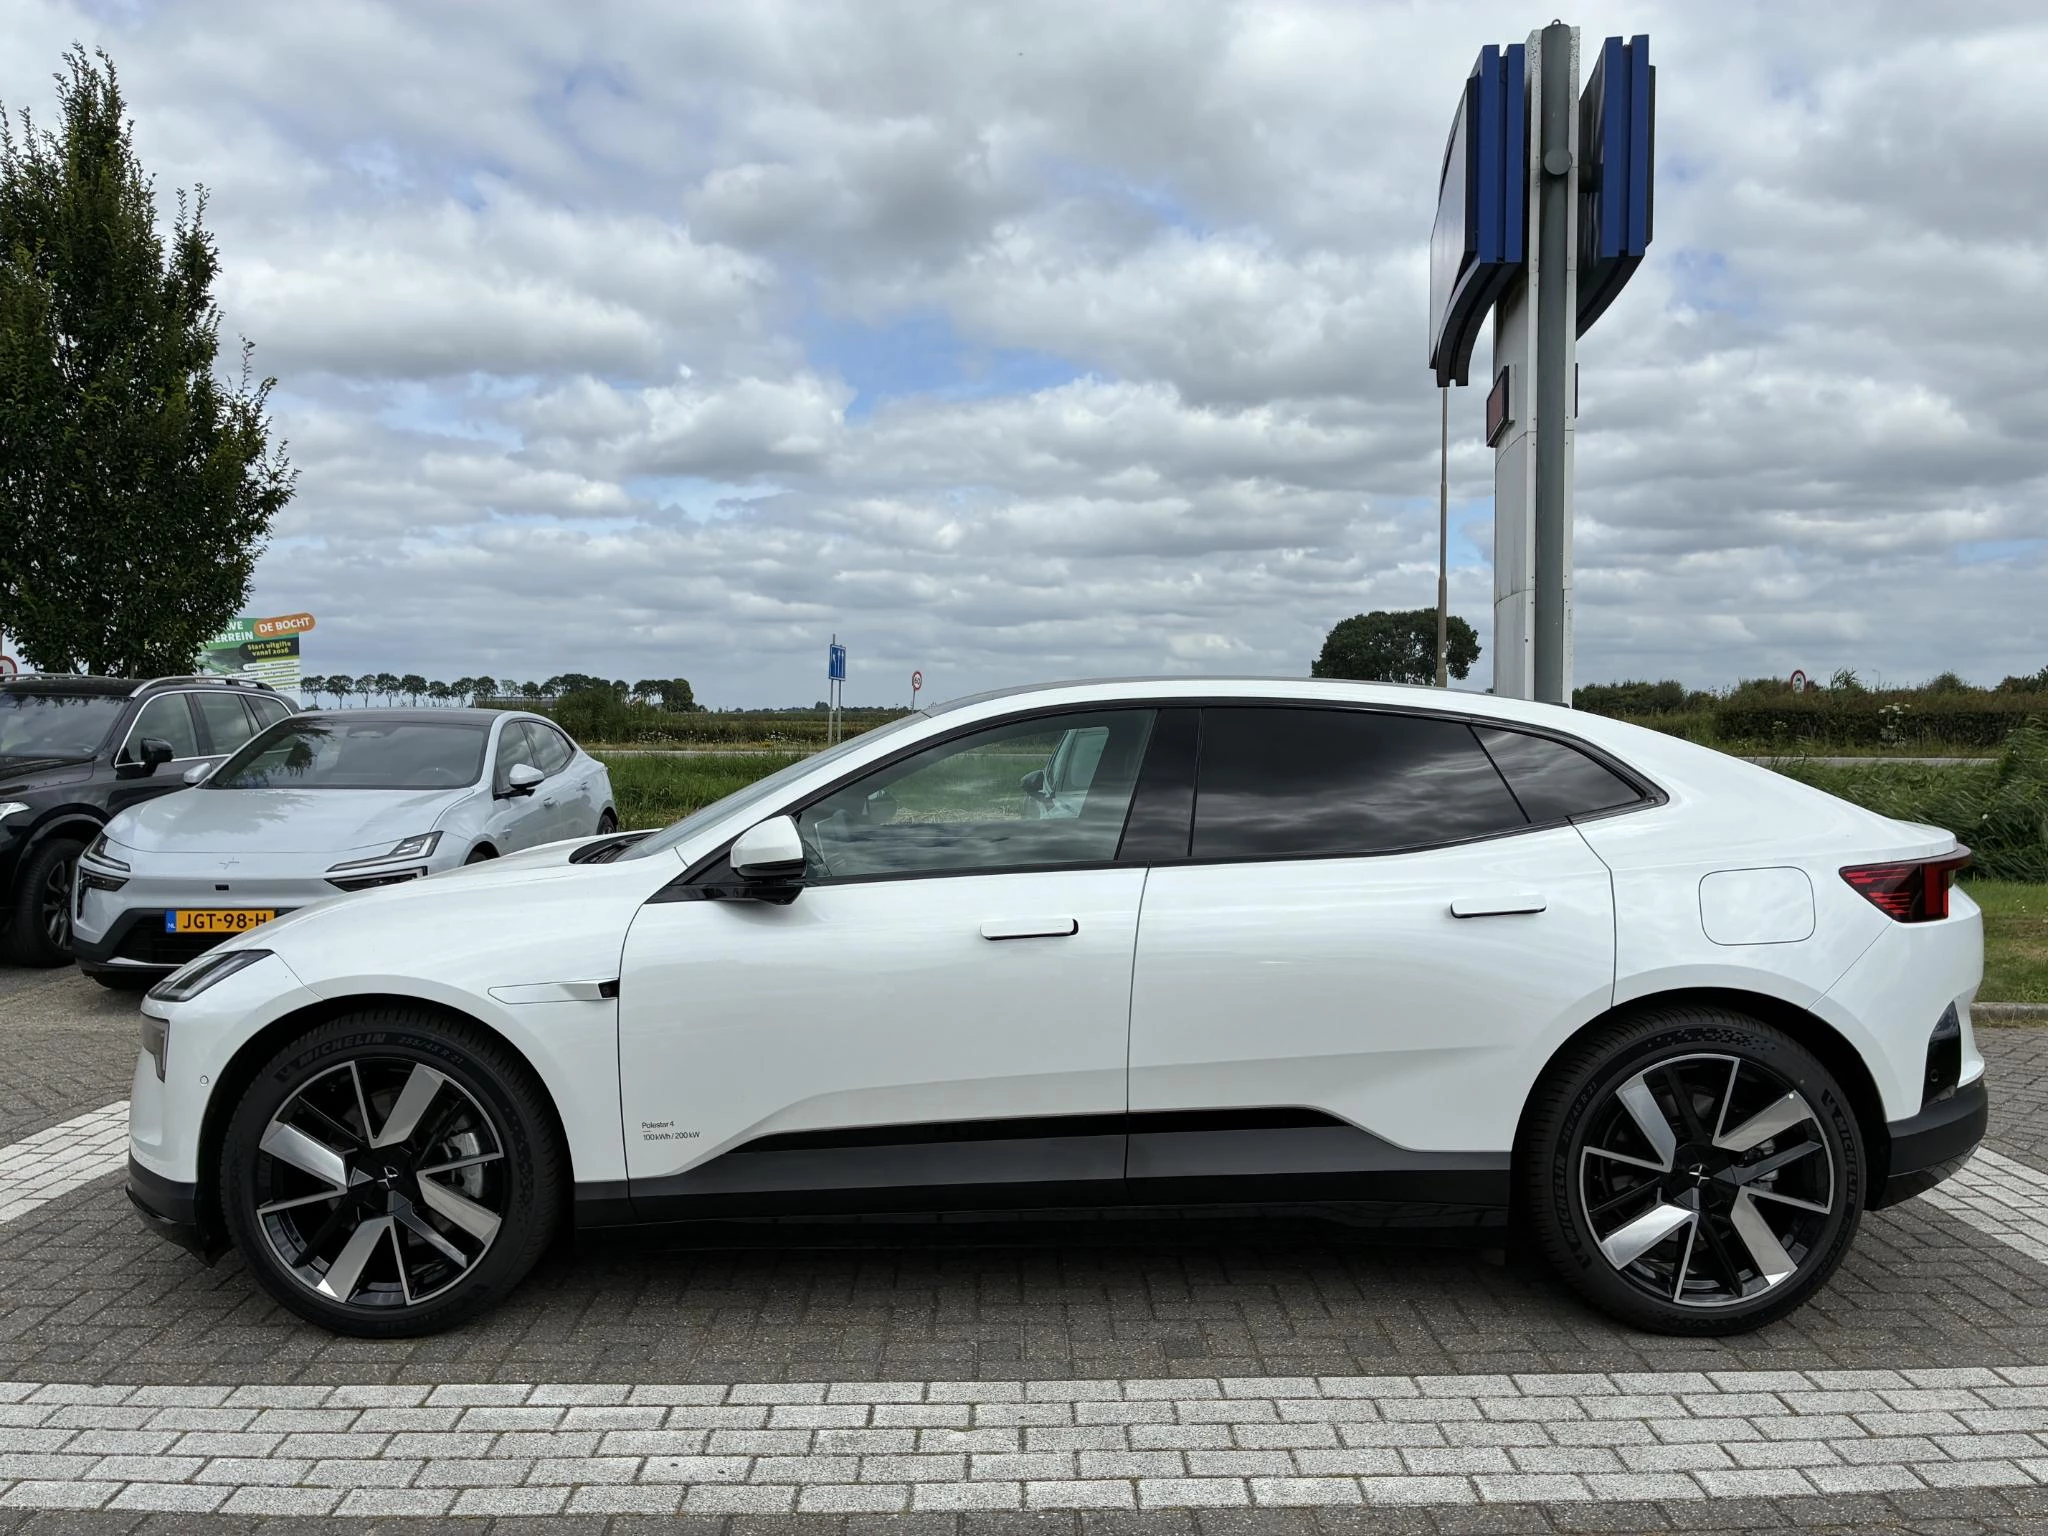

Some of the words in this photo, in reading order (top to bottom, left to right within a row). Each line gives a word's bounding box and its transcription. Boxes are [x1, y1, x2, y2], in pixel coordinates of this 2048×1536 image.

[258, 622, 273, 633] DE
[275, 617, 311, 631] BOCHT
[212, 631, 254, 644] ERREIN
[247, 642, 265, 651] Start
[252, 648, 272, 657] vanaf
[183, 913, 267, 929] JGT-98-H
[300, 1032, 387, 1065] MICHELIN
[641, 1121, 669, 1129] Polestar
[643, 1133, 655, 1141] 100
[655, 1132, 671, 1140] kWh
[675, 1131, 689, 1139] 200
[689, 1131, 701, 1139] kW
[1554, 1156, 1578, 1243] MICHELIN
